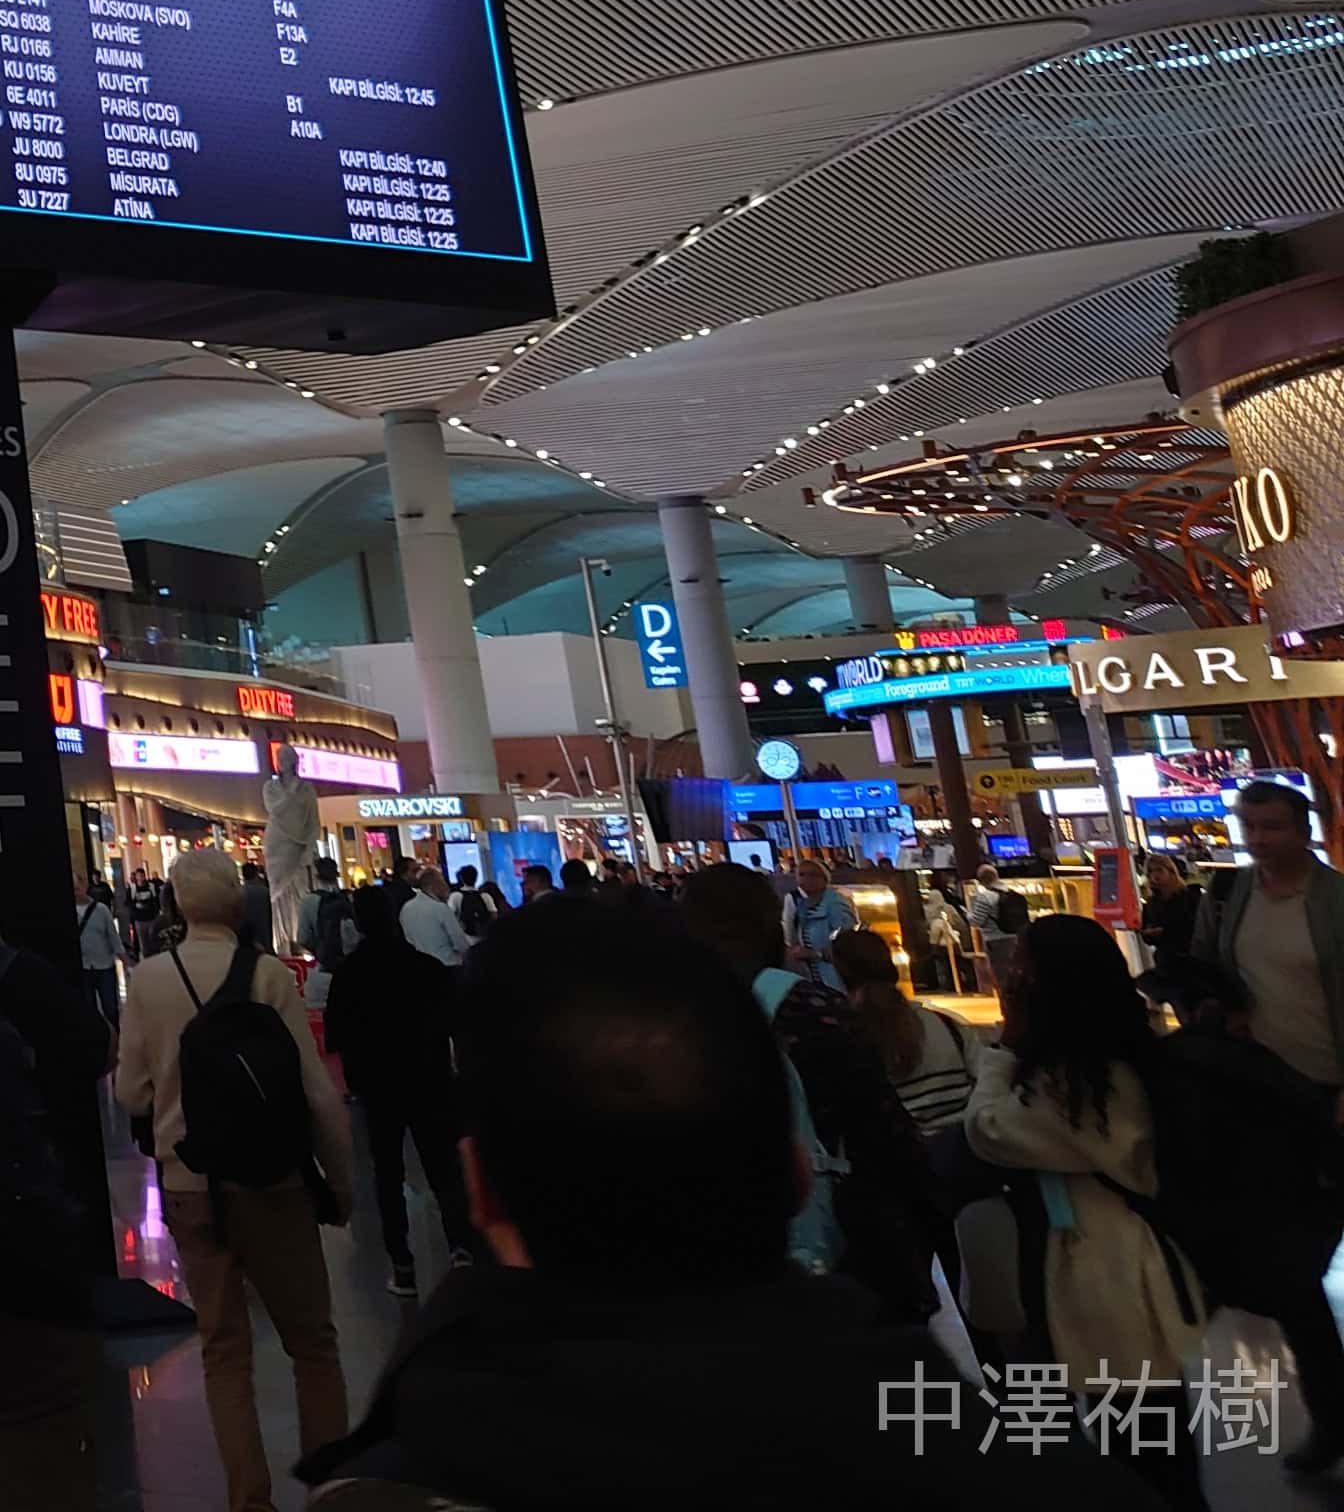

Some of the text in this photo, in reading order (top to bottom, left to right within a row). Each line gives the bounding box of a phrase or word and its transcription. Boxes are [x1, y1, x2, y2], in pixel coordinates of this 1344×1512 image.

[32, 113, 64, 134] 5772
[103, 121, 158, 144] LONDRA
[159, 128, 198, 153] (LGW)
[339, 149, 367, 167] KAPI
[415, 158, 446, 177] 12:40
[62, 596, 99, 638] FREE
[641, 604, 672, 638] D
[884, 675, 950, 698] Foreground
[358, 796, 463, 818] SWAROVSKI
